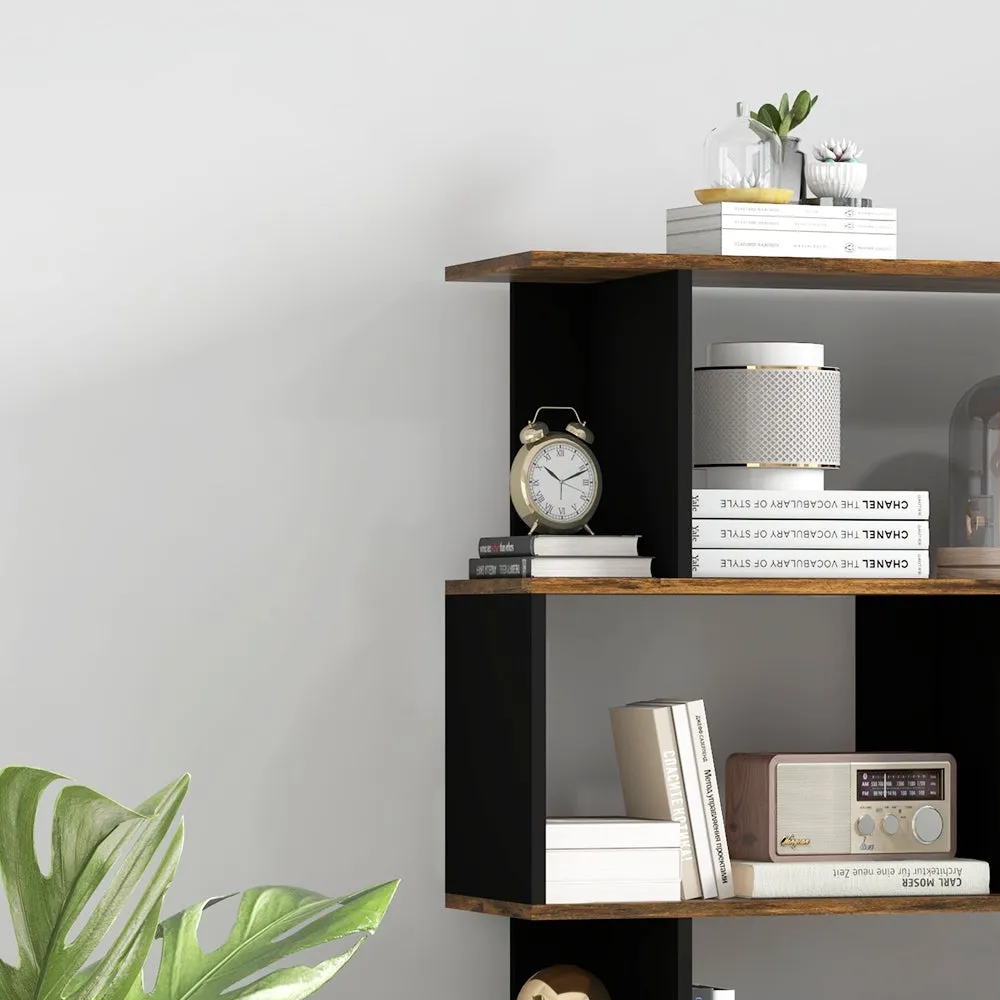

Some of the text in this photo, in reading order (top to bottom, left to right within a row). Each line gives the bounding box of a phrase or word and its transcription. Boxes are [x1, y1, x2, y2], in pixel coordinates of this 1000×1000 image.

[720, 500, 750, 508] STYLE
[754, 500, 767, 508] OF
[770, 500, 838, 509] VOCABULARY
[841, 500, 859, 509] THE
[862, 500, 908, 509] CHANEL
[720, 530, 908, 539] CHANEL THE VOCABULARY OF STYLE
[720, 559, 908, 568] CHANEL THE VOCABULARY OF STYLE
[663, 750, 683, 805] СПАСИТЕ
[703, 769, 729, 884] Метод управления проектами
[833, 869, 850, 878] Zeit
[876, 868, 895, 877] eine
[898, 868, 910, 877] für
[913, 867, 962, 877] Architektur
[902, 878, 962, 887] CARL MOSER
